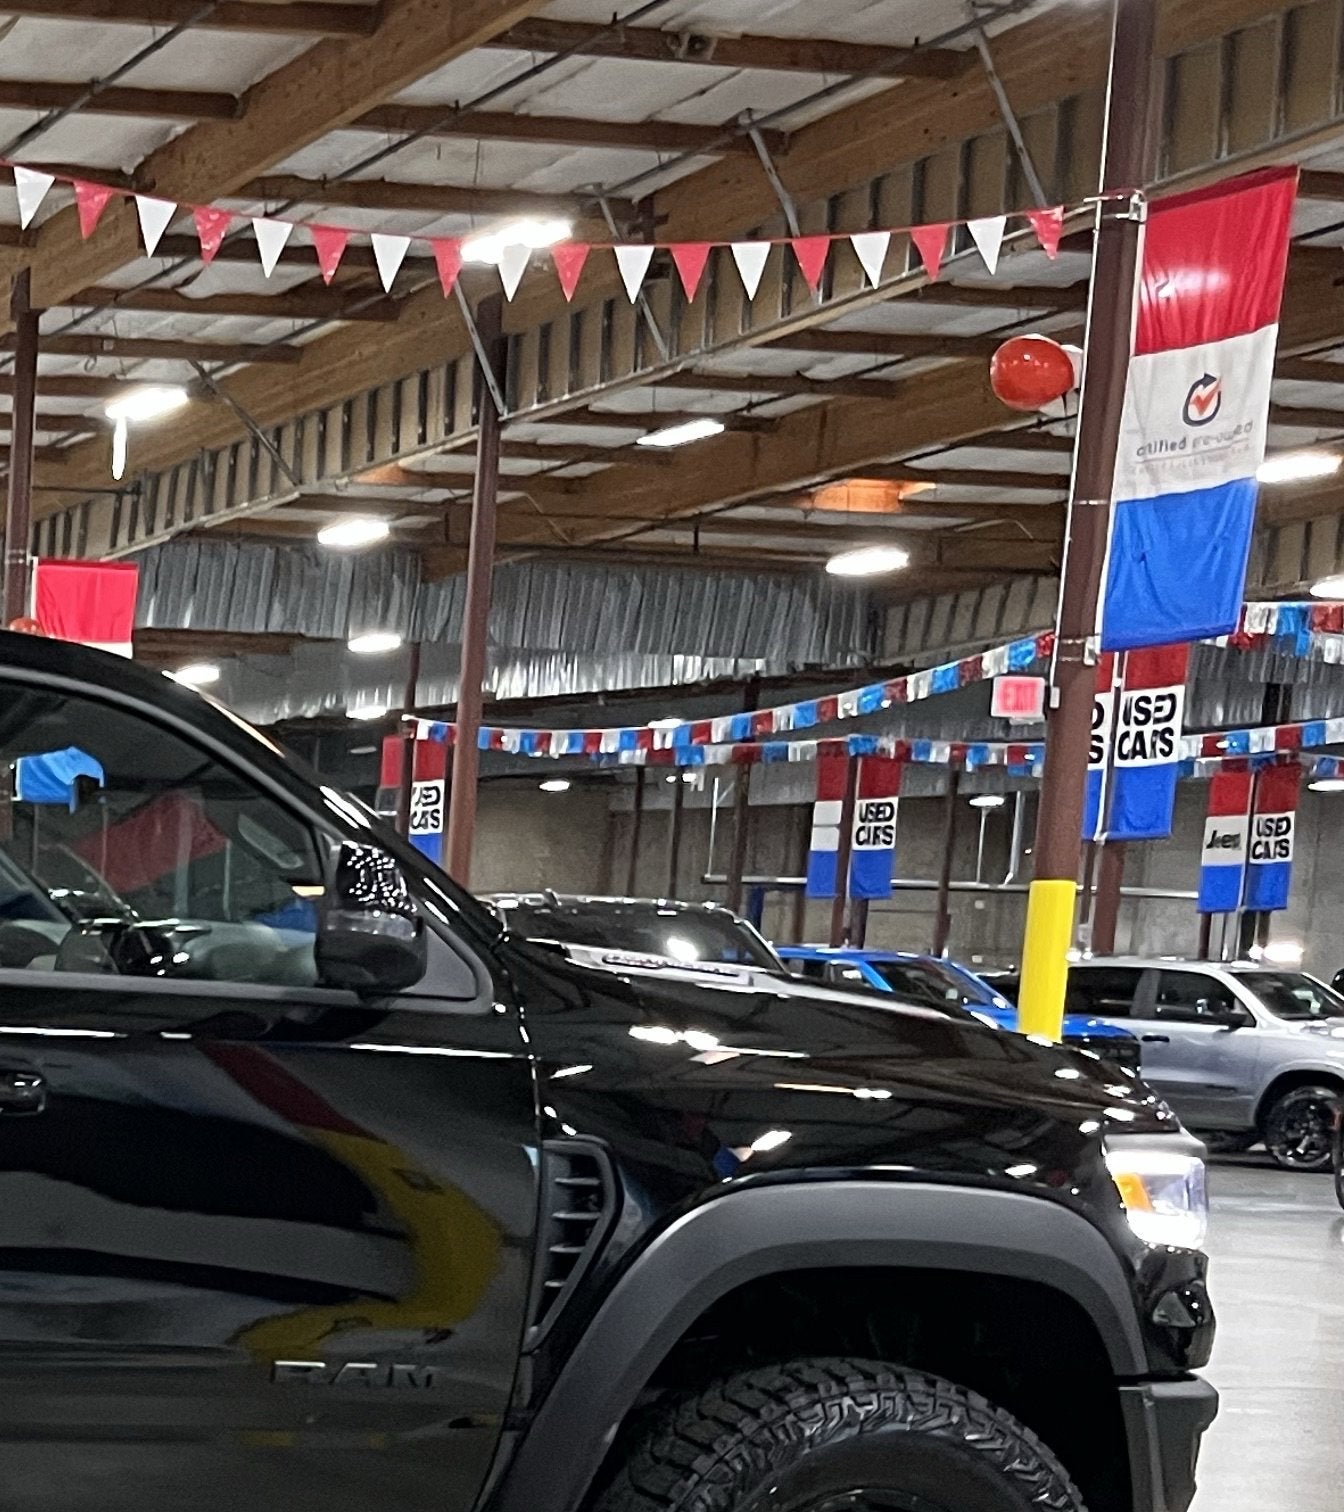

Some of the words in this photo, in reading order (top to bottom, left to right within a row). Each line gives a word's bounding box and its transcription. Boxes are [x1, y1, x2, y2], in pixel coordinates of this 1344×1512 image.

[1123, 694, 1176, 726] USED
[859, 802, 895, 823] USED
[1257, 816, 1291, 837] USED
[270, 1360, 438, 1388] RAM
